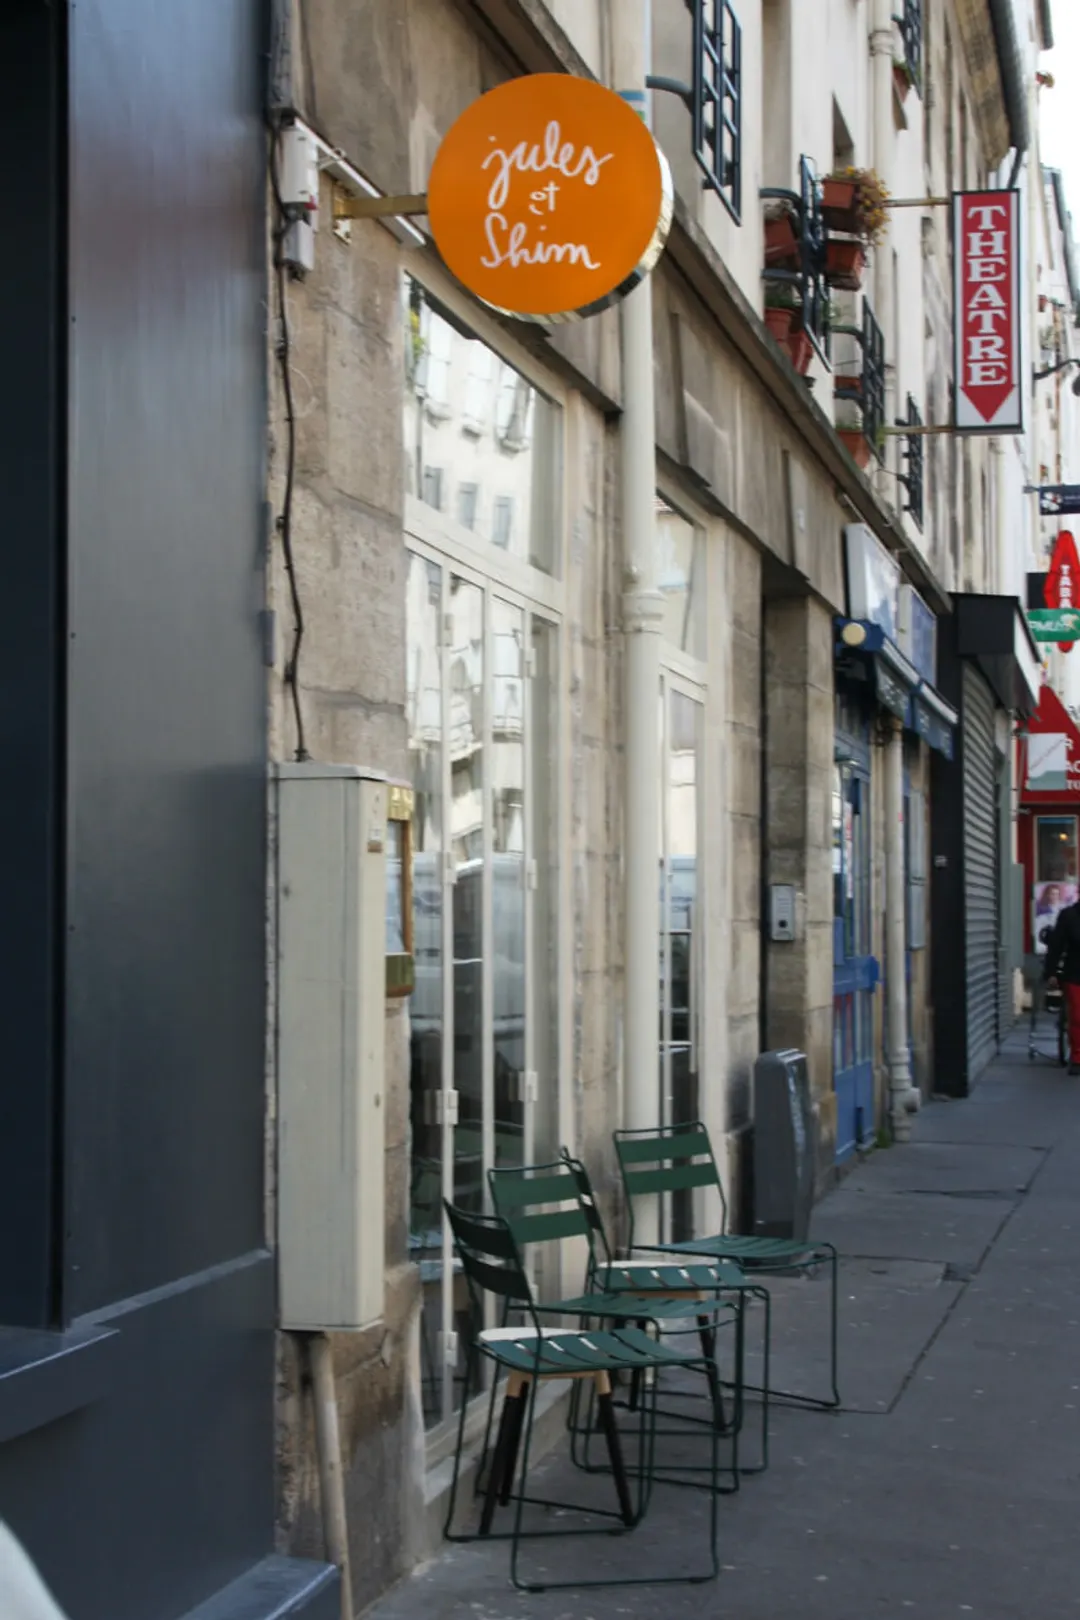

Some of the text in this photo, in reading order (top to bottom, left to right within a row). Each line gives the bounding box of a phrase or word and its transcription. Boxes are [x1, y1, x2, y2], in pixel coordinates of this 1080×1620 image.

[481, 120, 614, 210] jules
[528, 181, 560, 215] et
[480, 212, 601, 270] Shim
[966, 205, 1007, 387] THEATRE
[1059, 564, 1073, 608] TABA
